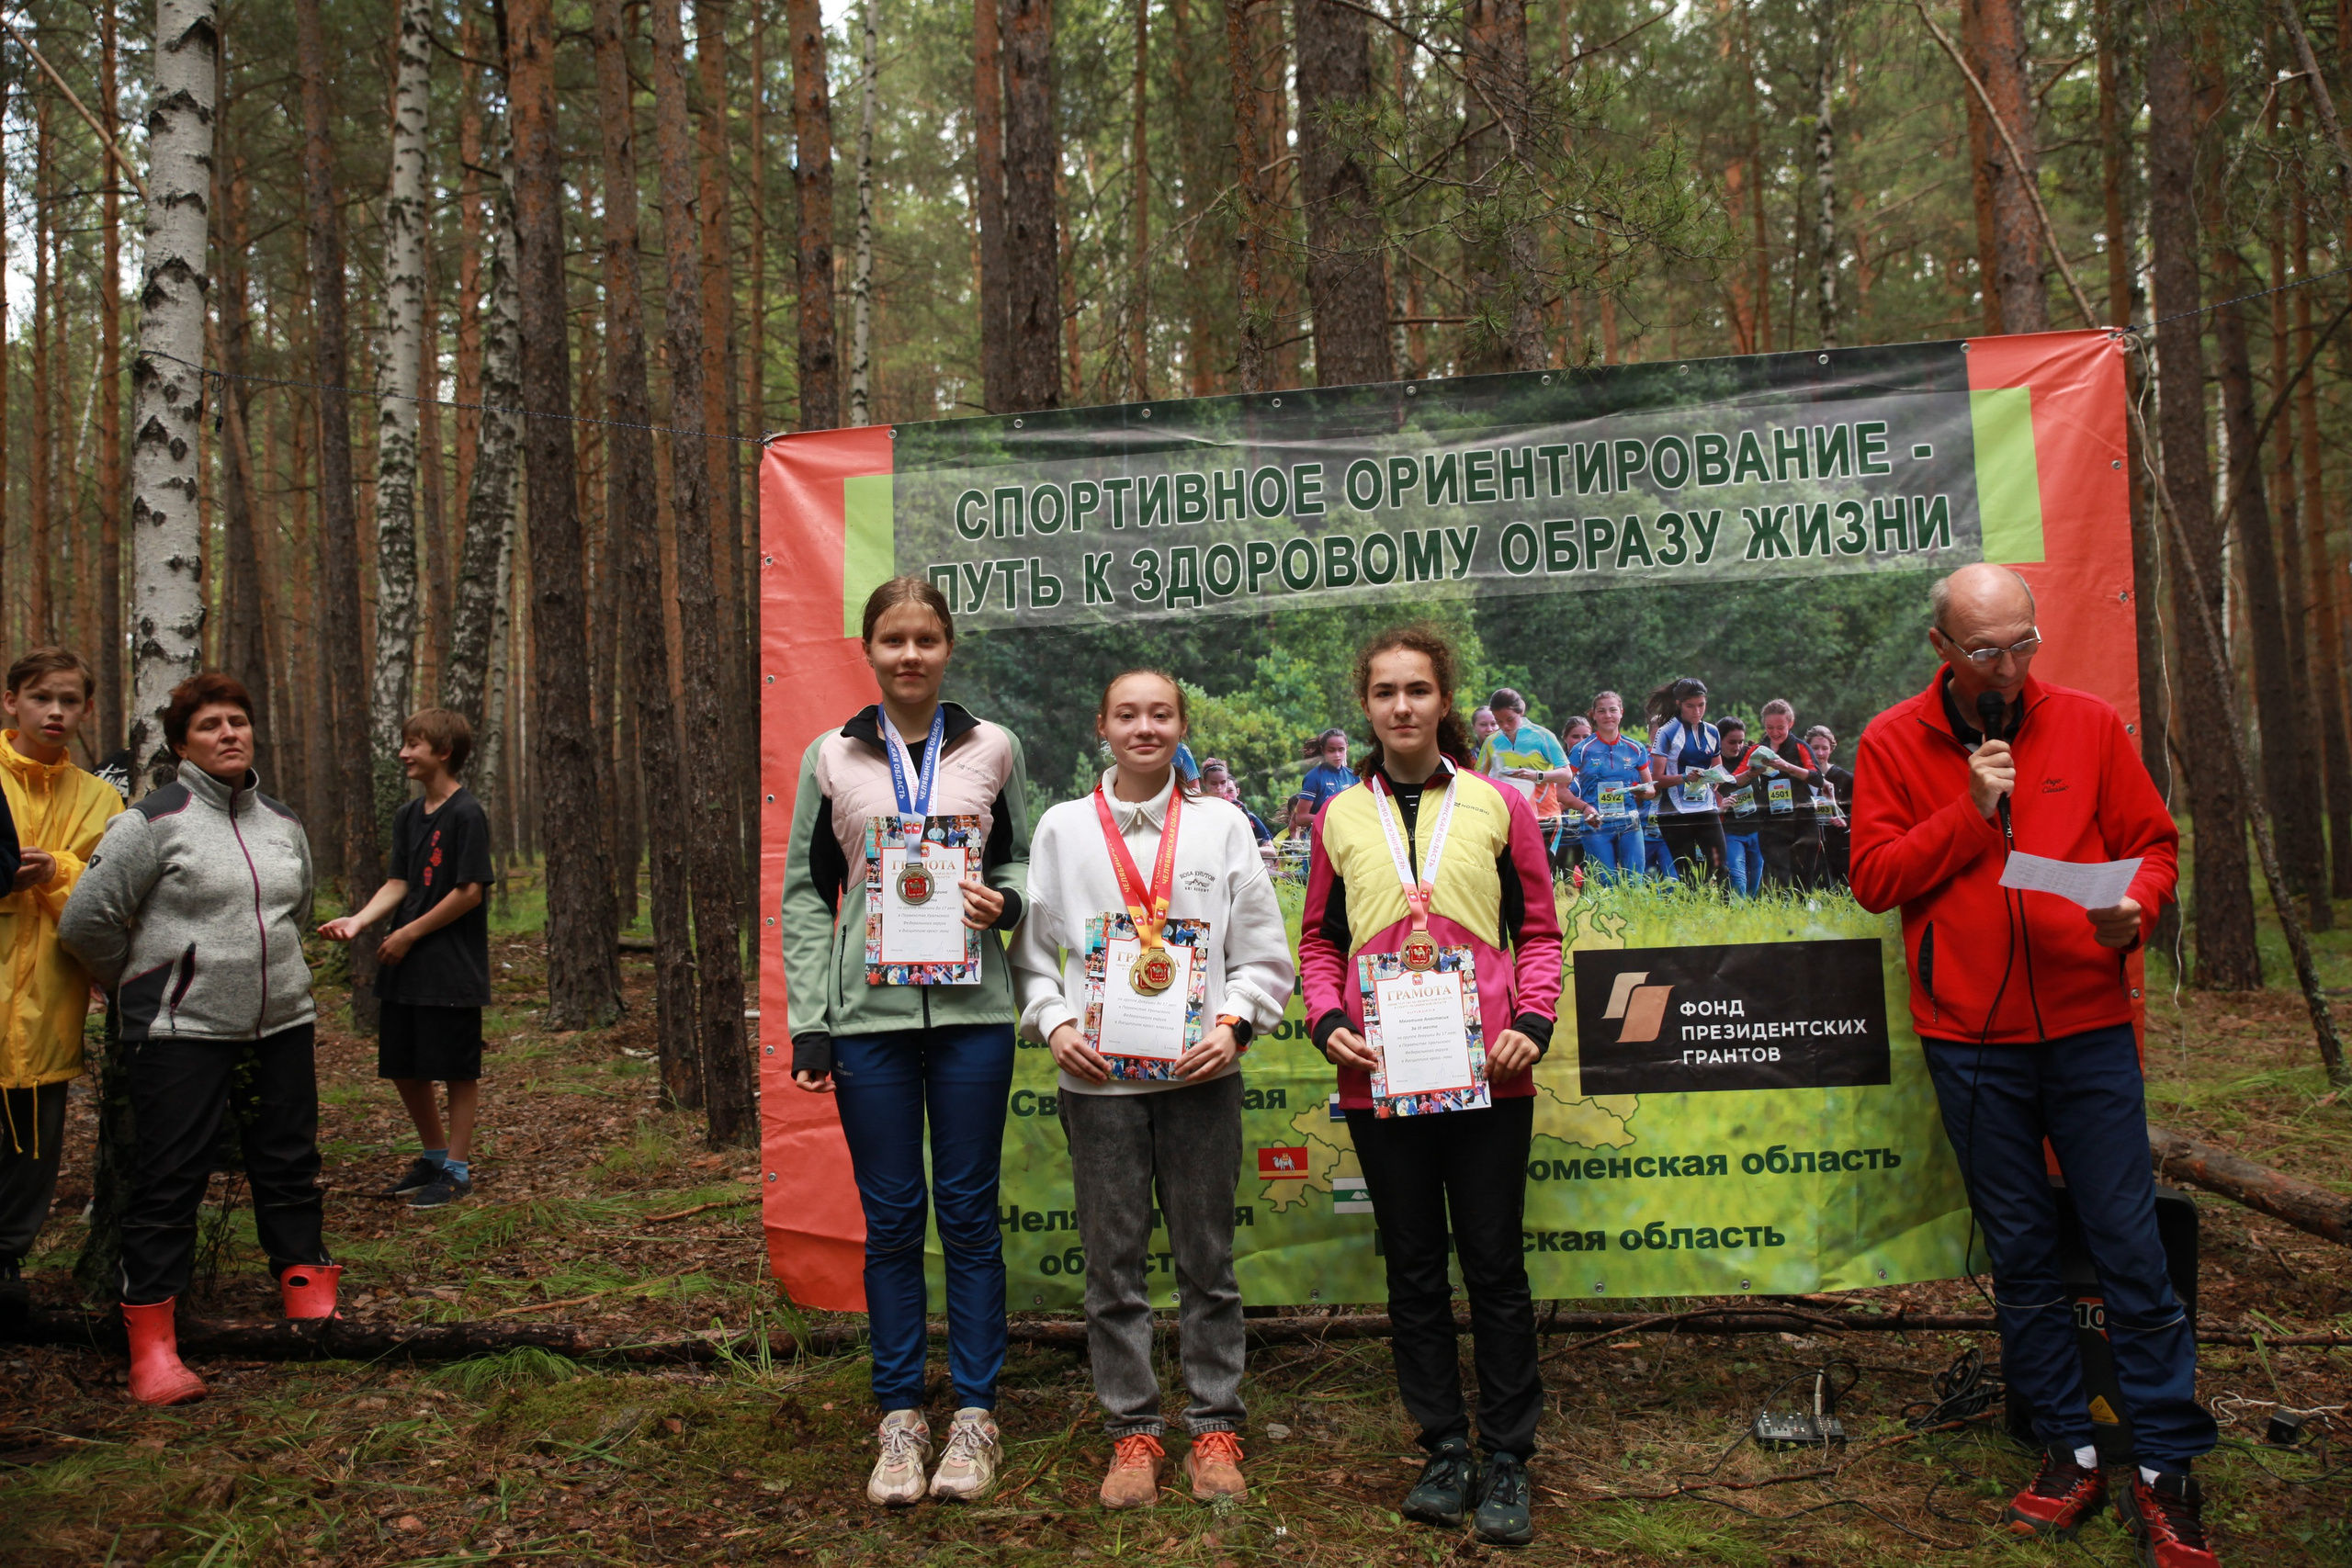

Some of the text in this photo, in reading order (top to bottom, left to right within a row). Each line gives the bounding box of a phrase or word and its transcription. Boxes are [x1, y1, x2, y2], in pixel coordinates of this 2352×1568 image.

[956, 420, 1932, 541] СПОРТИВНОЕ ОРИЕНТИРОВАНИЕ -
[928, 494, 1951, 615] ПУТЬ К ЗДОРОВОМУ ОБРАЗУ ЖИЗНИ
[919, 717, 942, 800] ЧЕЛЯБИНСКАЯ ОБЛАСТЬ
[894, 764, 905, 799] ОБЛАСТЬ
[1162, 796, 1179, 885] ЧЕЛЯБИНСКАЯ ОБЛАСТЬ
[1376, 786, 1406, 869] ЧЕЛЯБИНСКАЯ ОБЛАСТЬ
[1428, 781, 1455, 868] ЧЕЛЯБИНСКАЯ ОБЛАСТЬ
[1179, 871, 1193, 880] ROSA
[1387, 985, 1452, 1001] ГРАМОТА
[1679, 999, 1745, 1017] ФОНД
[1681, 1019, 1868, 1041] ПРЕЗИДЕНТСКИХ
[1683, 1047, 1781, 1065] ГРАНТОВ
[1741, 1145, 1902, 1176] область
[1619, 1221, 1786, 1251] область
